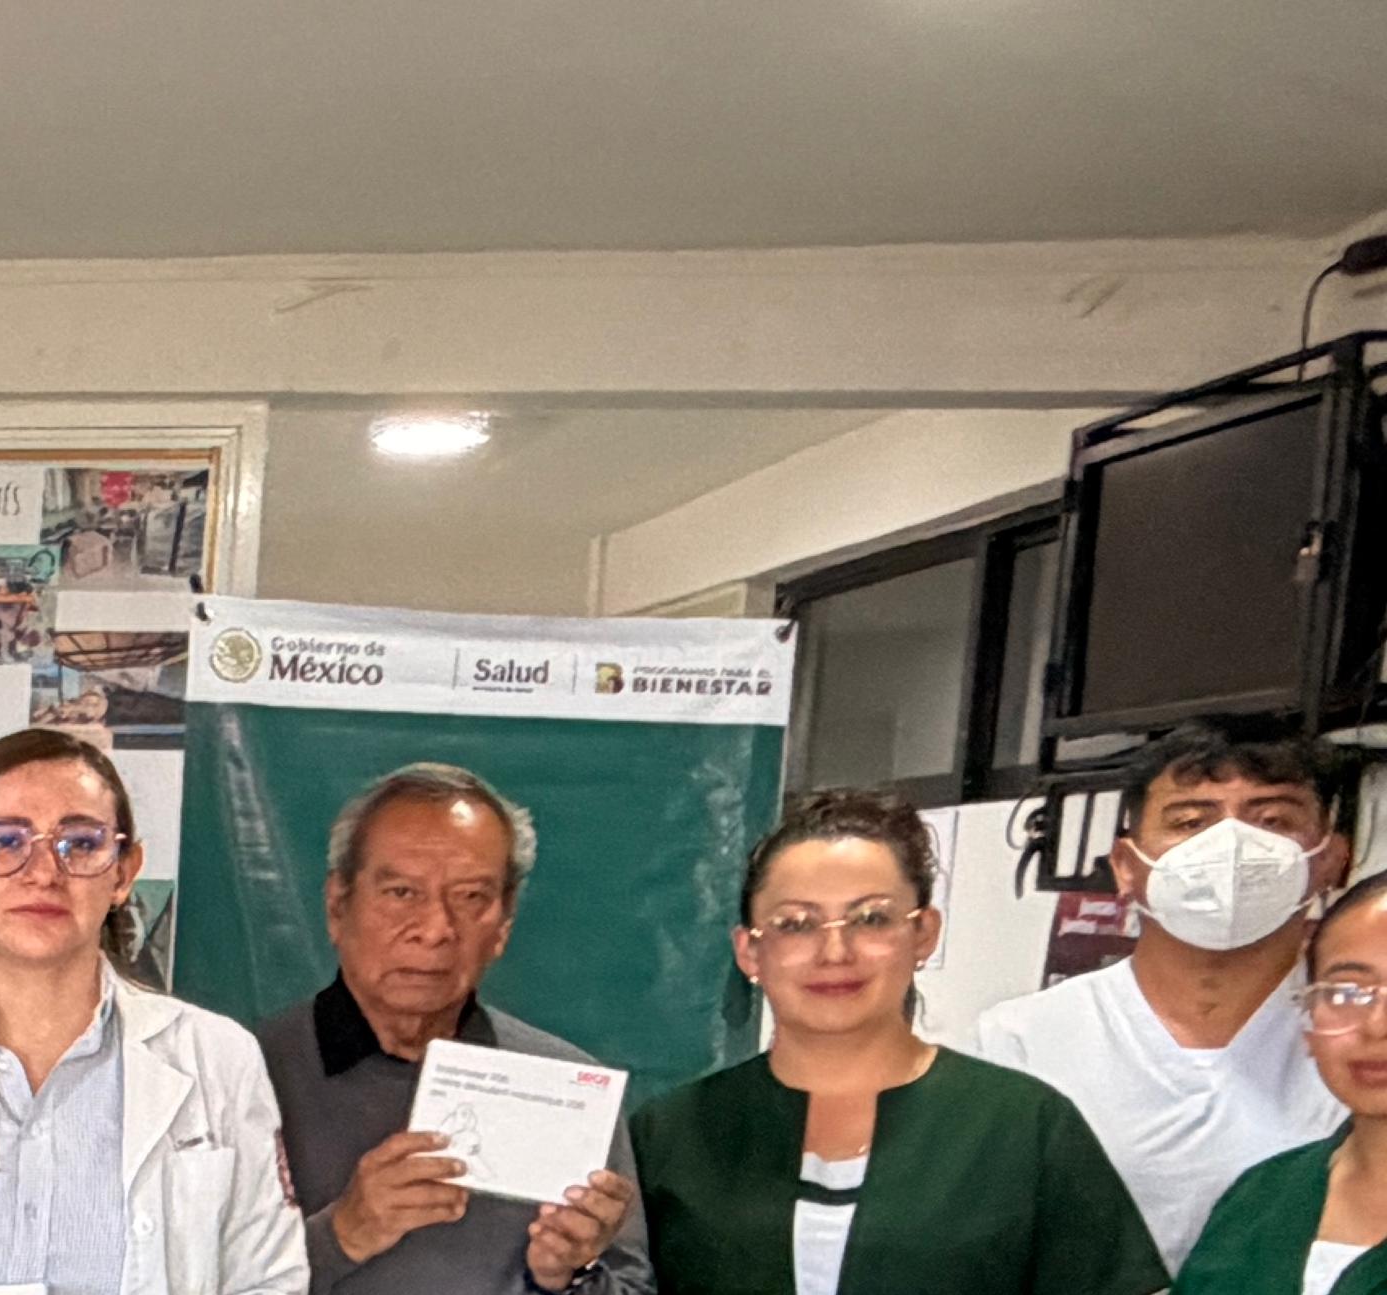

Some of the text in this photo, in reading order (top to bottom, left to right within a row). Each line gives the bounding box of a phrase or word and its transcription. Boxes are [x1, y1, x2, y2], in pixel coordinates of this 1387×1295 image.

[271, 635, 387, 656] Gobierno de
[269, 654, 384, 685] México
[473, 658, 550, 684] Salud
[631, 676, 773, 696] BIENESTAR
